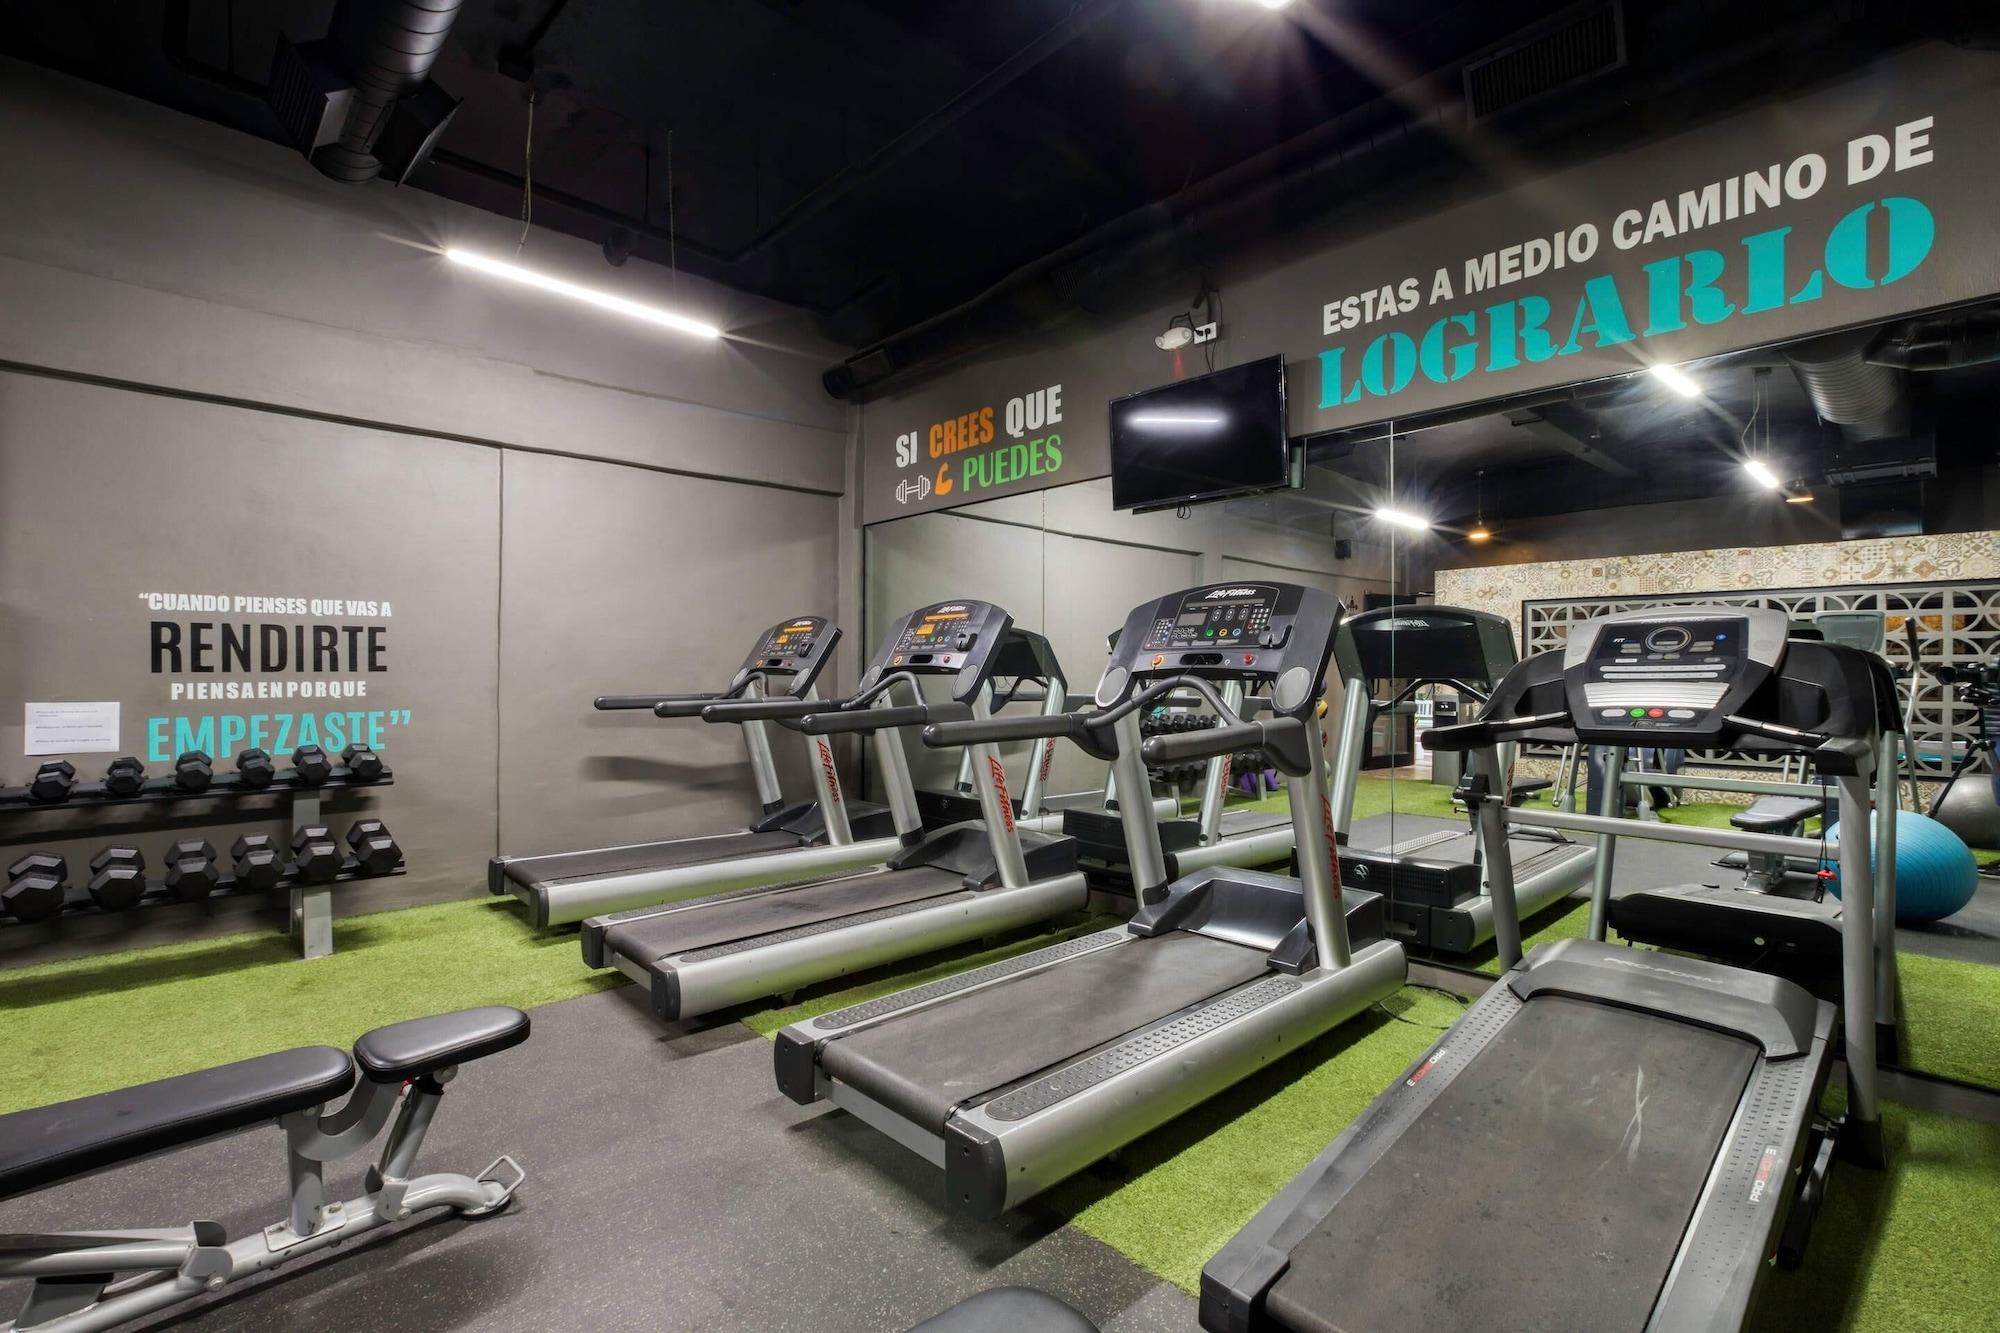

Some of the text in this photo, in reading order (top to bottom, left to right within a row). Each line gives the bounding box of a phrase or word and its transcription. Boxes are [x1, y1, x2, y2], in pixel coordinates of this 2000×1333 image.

[1323, 115, 1934, 335] ESTAS A MEDIO CAMINO DE
[1318, 196, 1935, 409] LOGRARLO
[895, 384, 1063, 468] SI CREES QUE
[963, 434, 1063, 492] PUEDES
[234, 596, 307, 615] PIENSES
[311, 598, 343, 617] QUE
[346, 600, 378, 617] VAS
[380, 601, 392, 617] A
[150, 621, 388, 674] RENDIRTE
